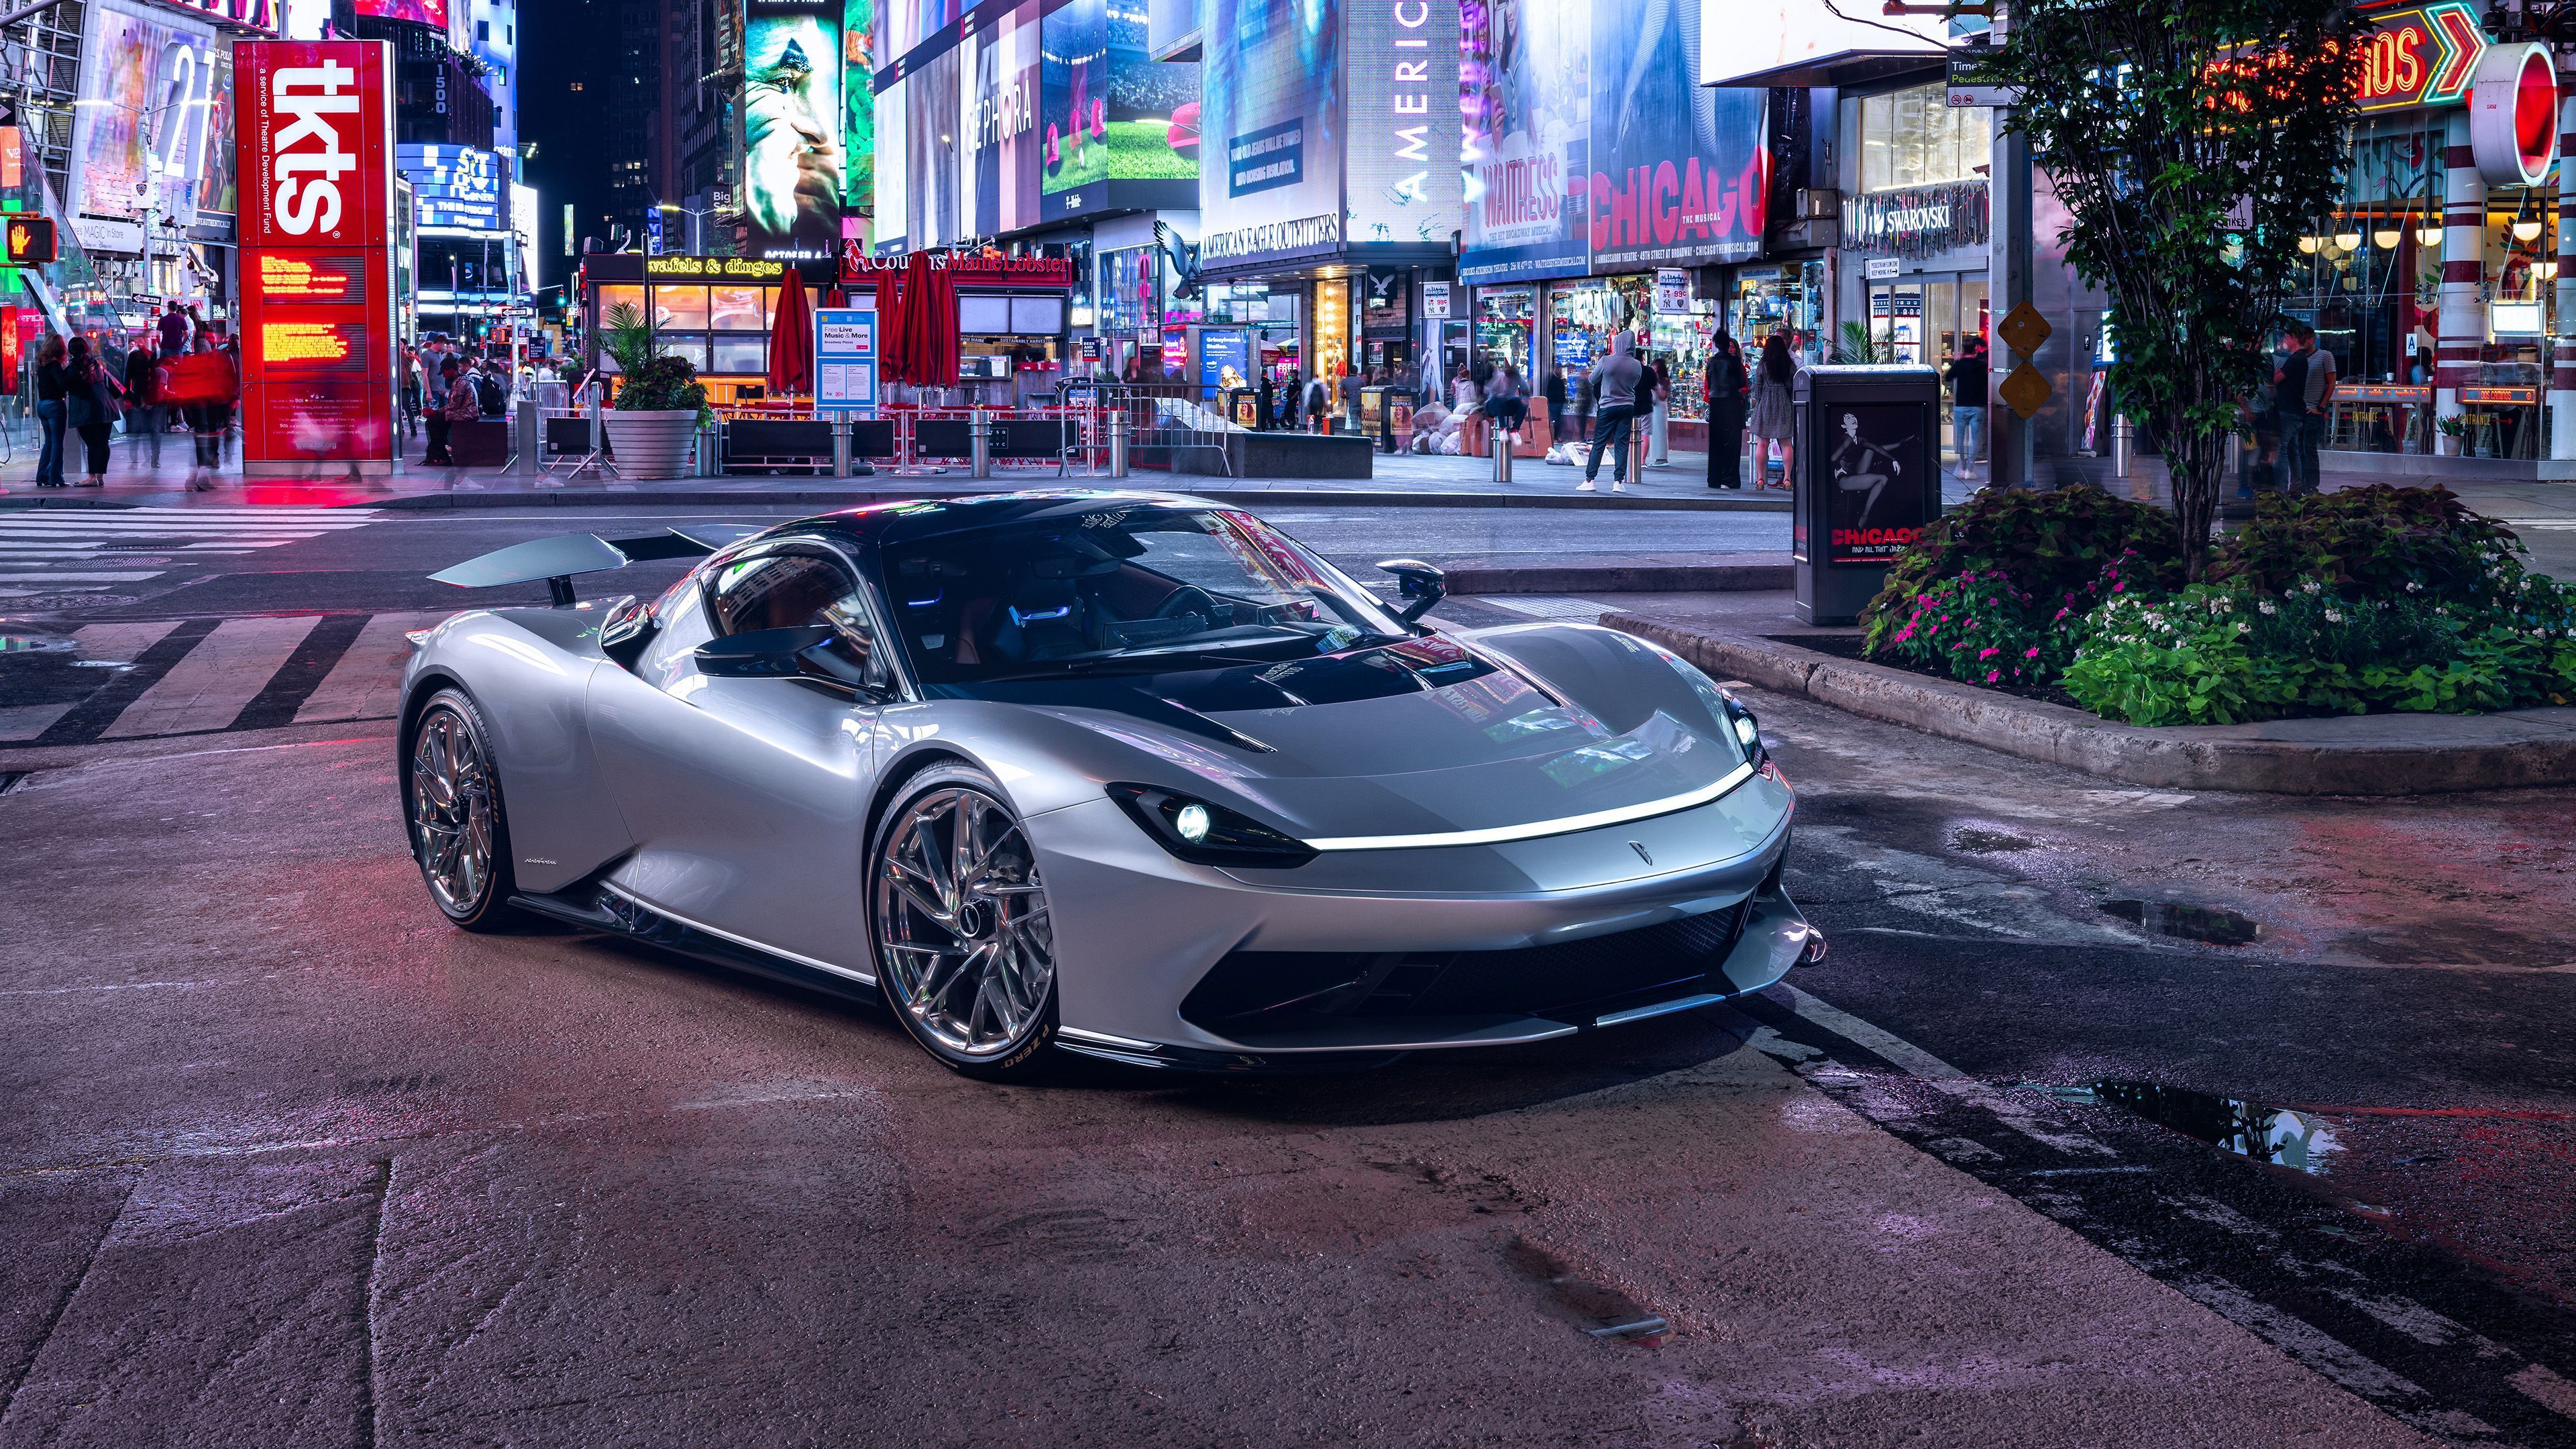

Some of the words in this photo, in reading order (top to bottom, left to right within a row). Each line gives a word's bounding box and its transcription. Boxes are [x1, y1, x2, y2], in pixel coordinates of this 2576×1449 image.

[221, 49, 232, 60] POLO
[436, 64, 446, 113] 1500
[260, 109, 268, 118] of
[968, 80, 1032, 153] SEPHORA
[261, 120, 269, 152] Theatre
[272, 59, 360, 235] tkts
[262, 155, 270, 211] Development
[1483, 152, 1558, 228] WAITRESS
[713, 191, 731, 203] Big
[1591, 145, 1774, 251] CHICAGO
[263, 213, 271, 233] Fund
[1682, 215, 1693, 223] THE
[1695, 212, 1721, 223] MUSICAL
[1887, 206, 1950, 233] SWAROVSKI
[111, 229, 123, 238] Store
[1203, 228, 1246, 260] AMERICAN
[1247, 223, 1274, 254] EAGLE
[1277, 213, 1337, 250] OUTFITTERS
[1506, 229, 1530, 239] BROADWAY
[1532, 225, 1552, 237] MUSICAL
[872, 249, 944, 270] Couns
[947, 250, 1003, 272] Maine
[1003, 251, 1069, 272] Lobster
[1598, 252, 1621, 264] AMBASSADOR
[1622, 252, 1638, 262] THEATRE
[1640, 250, 1650, 260] 49TH
[1651, 249, 1665, 260] STREET
[1666, 248, 1670, 258] AT
[1671, 246, 1693, 258] BROADWAY
[1696, 241, 1758, 256] CHICAGOTHEMUSICAL.COM
[648, 258, 702, 274] wafels
[706, 259, 720, 274] &
[725, 259, 782, 276] dinges
[1462, 268, 1476, 276] BROOKS
[1476, 265, 1493, 275] ATKINSON
[1493, 264, 1508, 273] THEATRE
[1535, 256, 1586, 269] WAITRESSTHEMUSICAL.COM
[2408, 336, 2415, 350] A
[2481, 390, 2490, 400] DOS
[2491, 390, 2512, 400] CAMINOS
[2353, 412, 2378, 423] ENTRANCE
[1004, 1036, 1040, 1068] ZERO
